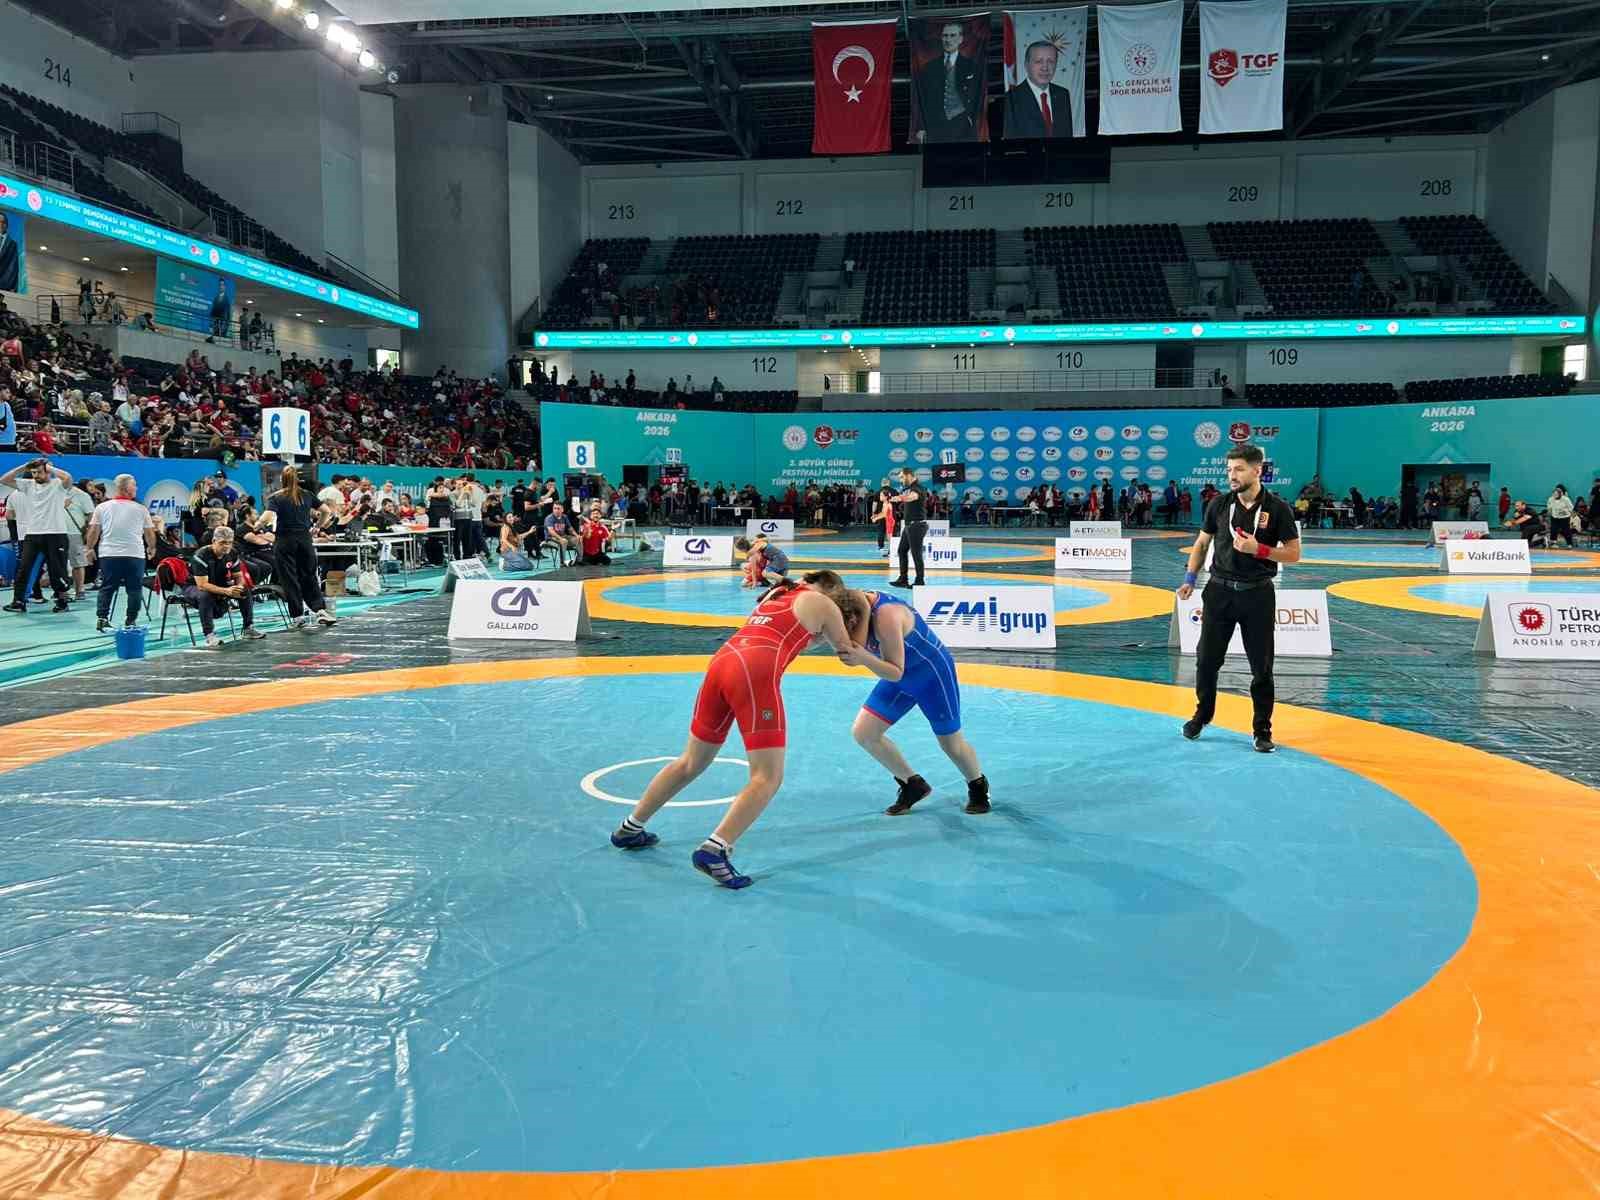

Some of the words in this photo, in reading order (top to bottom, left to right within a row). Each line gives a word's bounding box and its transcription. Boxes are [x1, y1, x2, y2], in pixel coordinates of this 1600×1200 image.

[1241, 53, 1279, 68] TGF
[44, 58, 72, 88] 214
[1110, 87, 1130, 96] SPOR
[1228, 185, 1258, 203] 209
[1420, 179, 1452, 196] 208
[776, 200, 803, 215] 212
[949, 195, 975, 210] 211
[1045, 192, 1074, 208] 210
[608, 204, 634, 220] 213
[952, 353, 976, 370] 111
[1056, 352, 1083, 369] 110
[1269, 348, 1298, 366] 109
[752, 357, 777, 373] 112
[636, 412, 677, 423] ANKARA
[1422, 406, 1476, 418] ANKARA
[270, 414, 281, 449] 6
[298, 415, 306, 450] 6
[644, 426, 670, 436] 2026
[1254, 426, 1280, 436] TGF
[1430, 421, 1464, 432] 2026
[834, 430, 860, 440] TGF
[576, 445, 587, 465] 8
[946, 452, 953, 461] 11
[932, 551, 958, 561] grup
[487, 622, 538, 630] GALLARDO
[1524, 614, 1538, 623] TP
